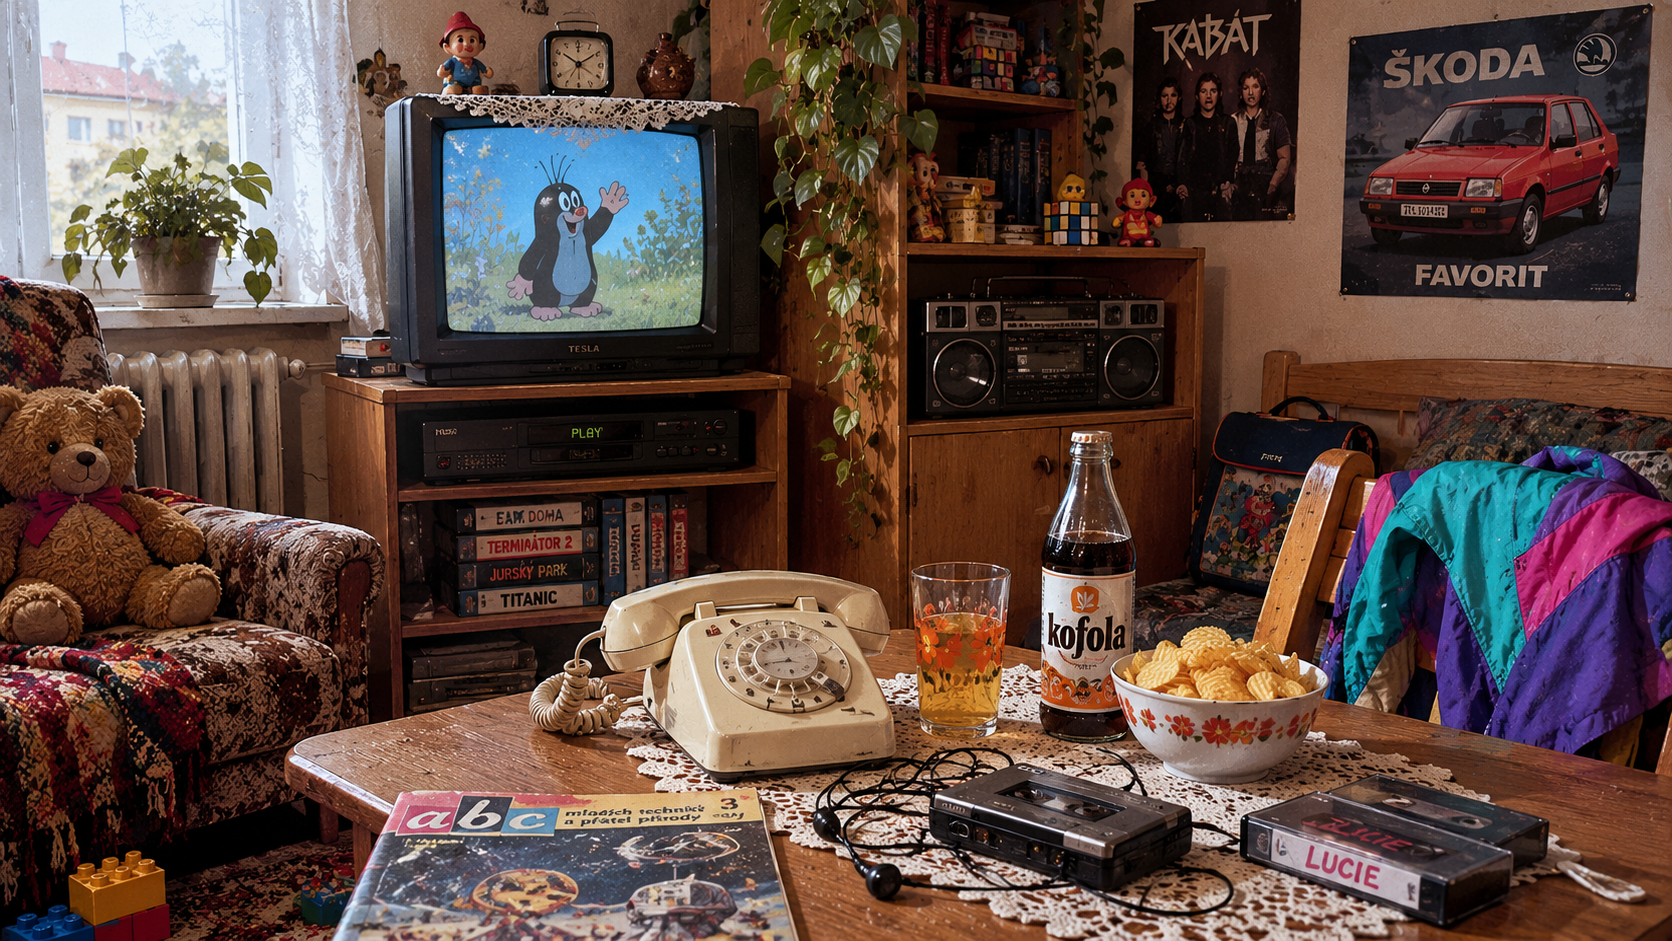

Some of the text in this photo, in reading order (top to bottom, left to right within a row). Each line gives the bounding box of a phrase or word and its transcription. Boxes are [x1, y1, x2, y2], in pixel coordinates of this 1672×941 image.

[1152, 9, 1273, 66] KABÁT
[1383, 44, 1546, 89] ŠKODA
[1415, 264, 1549, 288] FAVORIT
[568, 344, 600, 353] TESLA
[571, 427, 602, 439] PLAY
[564, 535, 573, 549] 2
[538, 563, 569, 578] PARK
[500, 590, 558, 608] TITANIC
[1047, 612, 1126, 659] kofola
[720, 797, 739, 810] 3
[406, 799, 547, 830] abc
[1305, 845, 1381, 890] LUCIE
